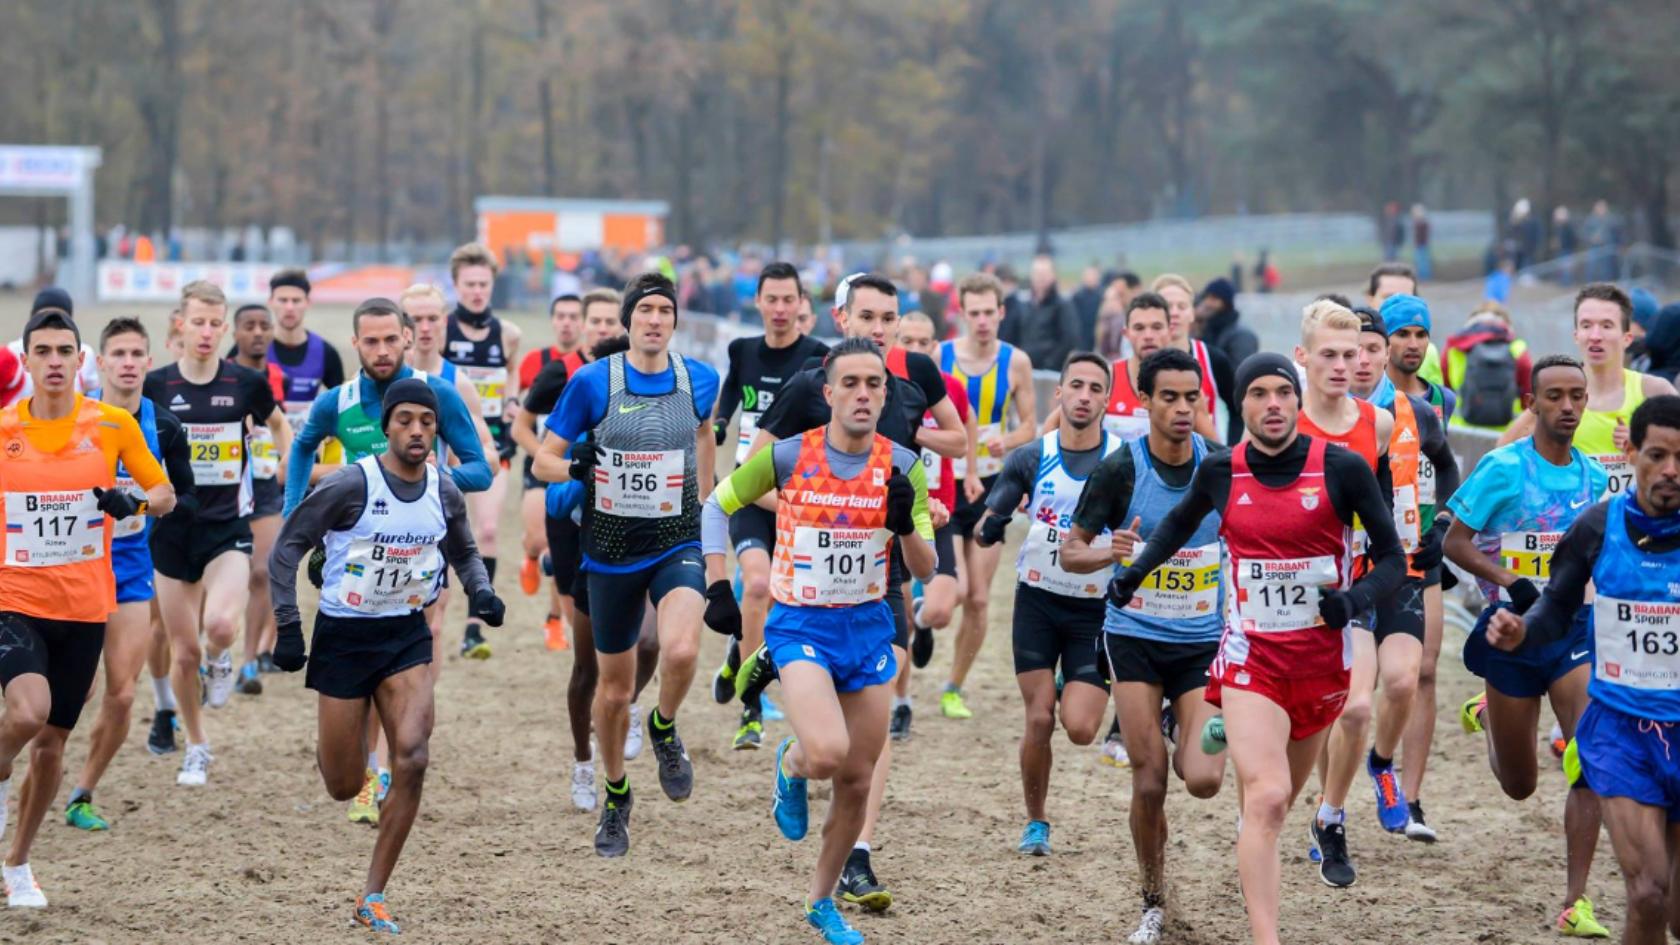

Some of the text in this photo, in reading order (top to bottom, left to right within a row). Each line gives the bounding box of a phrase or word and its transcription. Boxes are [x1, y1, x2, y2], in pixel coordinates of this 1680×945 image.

[196, 444, 219, 461] 29
[624, 453, 665, 461] BRABANT
[624, 461, 652, 470] SPORT
[1605, 462, 1627, 470] PORT
[617, 473, 658, 492] 156
[1608, 474, 1633, 494] 07
[40, 493, 84, 503] BRABANT
[40, 502, 72, 512] SPORT
[33, 515, 78, 538] 117
[373, 532, 436, 544] Tureberg
[1540, 534, 1562, 543] BRAB
[833, 540, 864, 549] SPORT
[1540, 543, 1555, 551] SPO
[824, 553, 866, 575] 101
[1265, 561, 1311, 571] BRABANT
[1531, 555, 1551, 576] 1
[374, 567, 413, 588] 111
[833, 577, 857, 585] Khalid
[1151, 569, 1195, 591] 153
[1265, 571, 1298, 580] SPORT
[1259, 584, 1307, 607] 112
[1634, 604, 1680, 615] BRABAN
[1634, 614, 1671, 625] SPORT
[1626, 629, 1679, 656] 163
